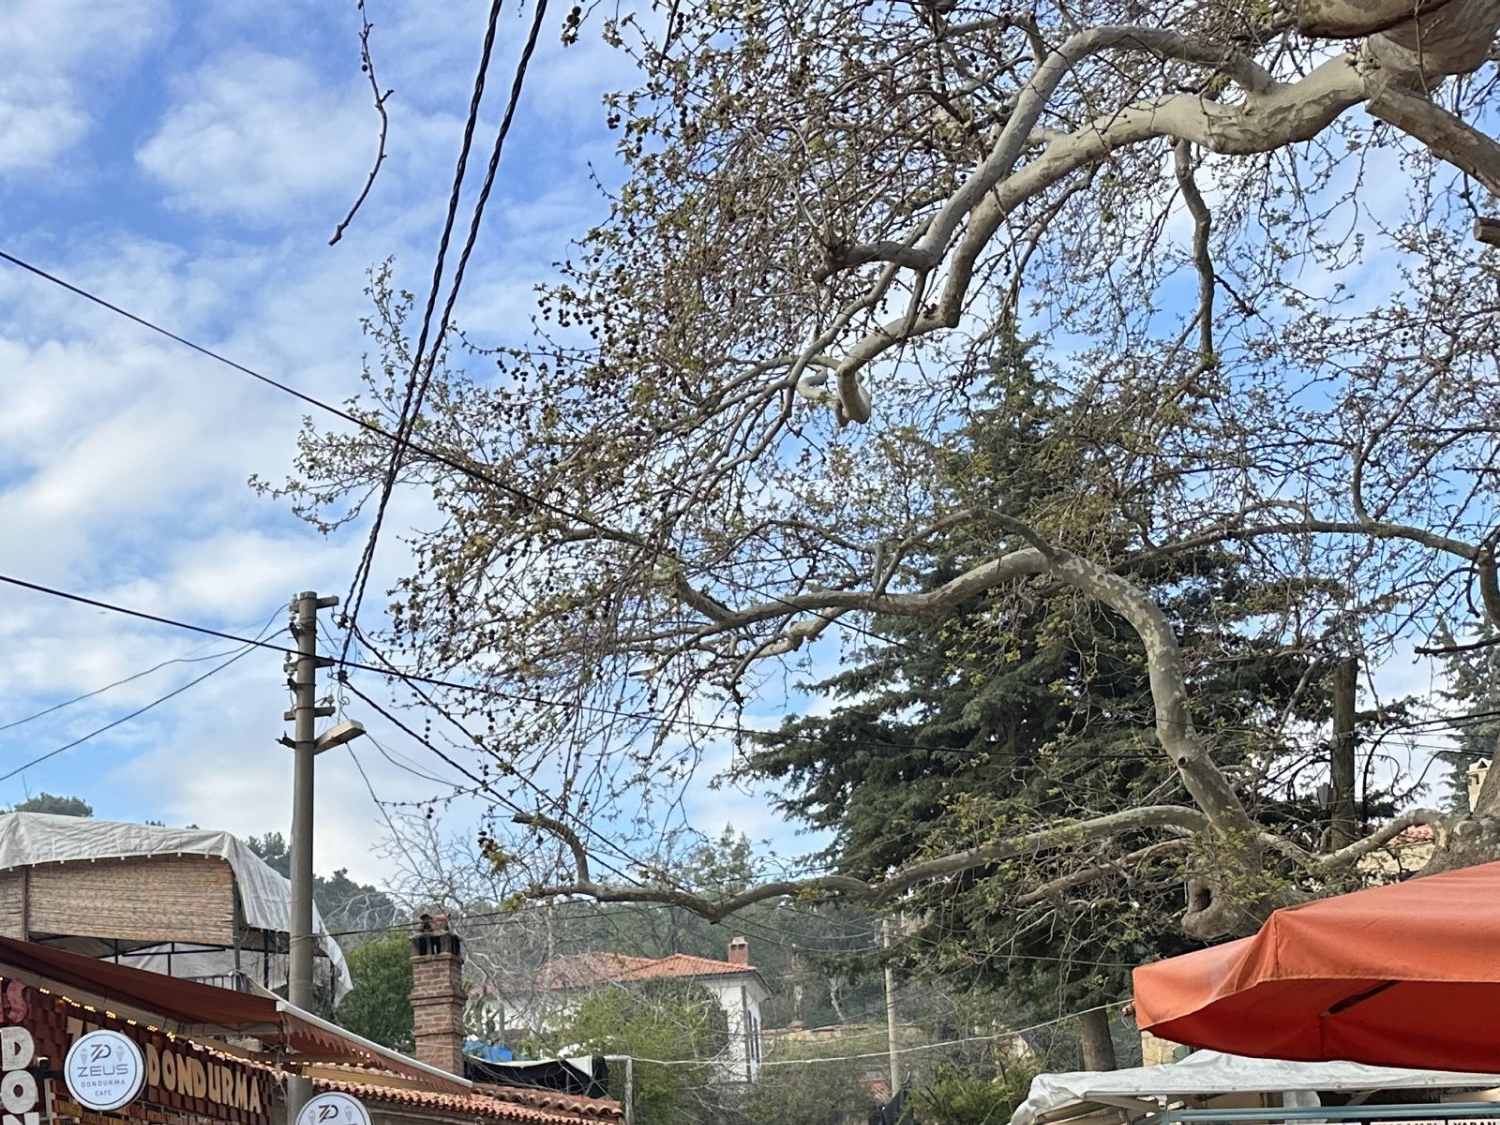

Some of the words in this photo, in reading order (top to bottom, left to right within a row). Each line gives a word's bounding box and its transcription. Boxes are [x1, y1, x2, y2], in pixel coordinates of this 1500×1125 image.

[77, 1064, 128, 1077] ZEUS
[81, 1079, 125, 1088] DONDURMA
[146, 1043, 261, 1114] DONDURMA
